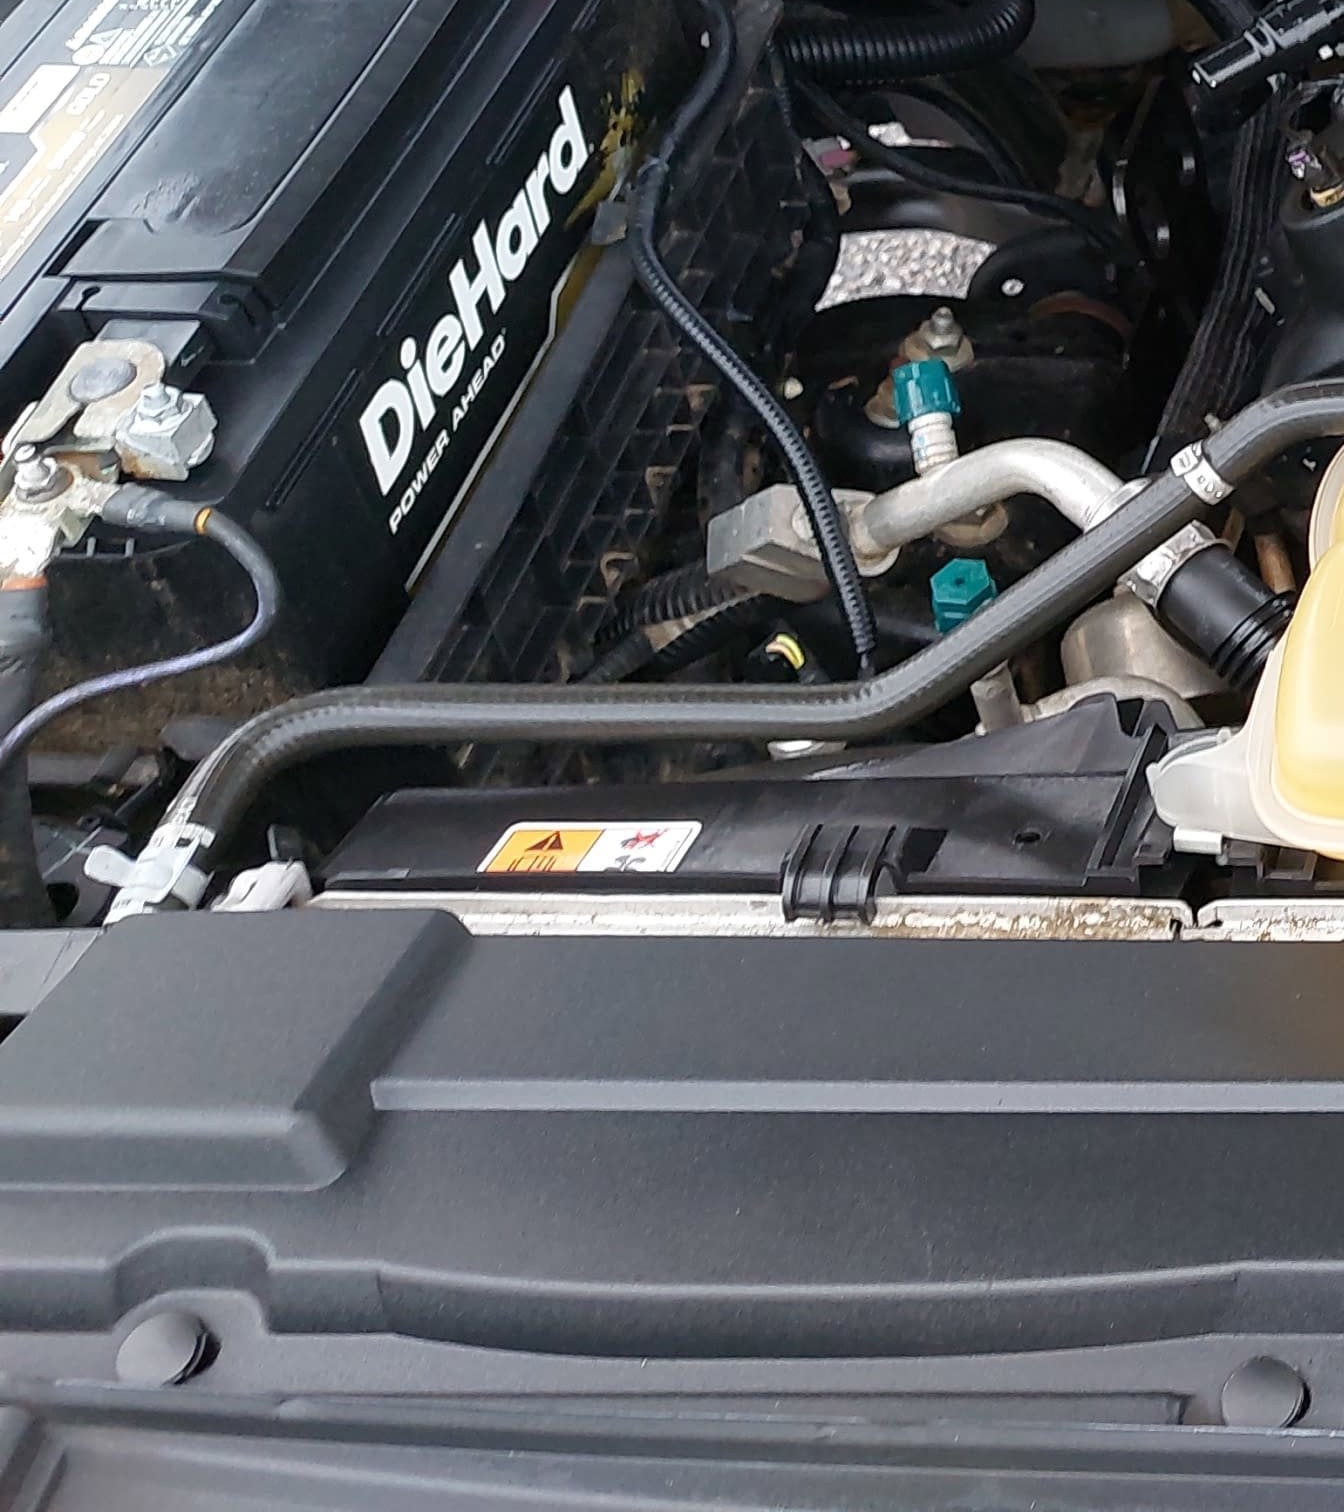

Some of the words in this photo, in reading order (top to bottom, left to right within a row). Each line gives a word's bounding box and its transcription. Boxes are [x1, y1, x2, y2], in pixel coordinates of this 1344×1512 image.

[359, 85, 589, 497] DieHard
[388, 428, 451, 535] POWER
[452, 333, 505, 432] AHEAD
